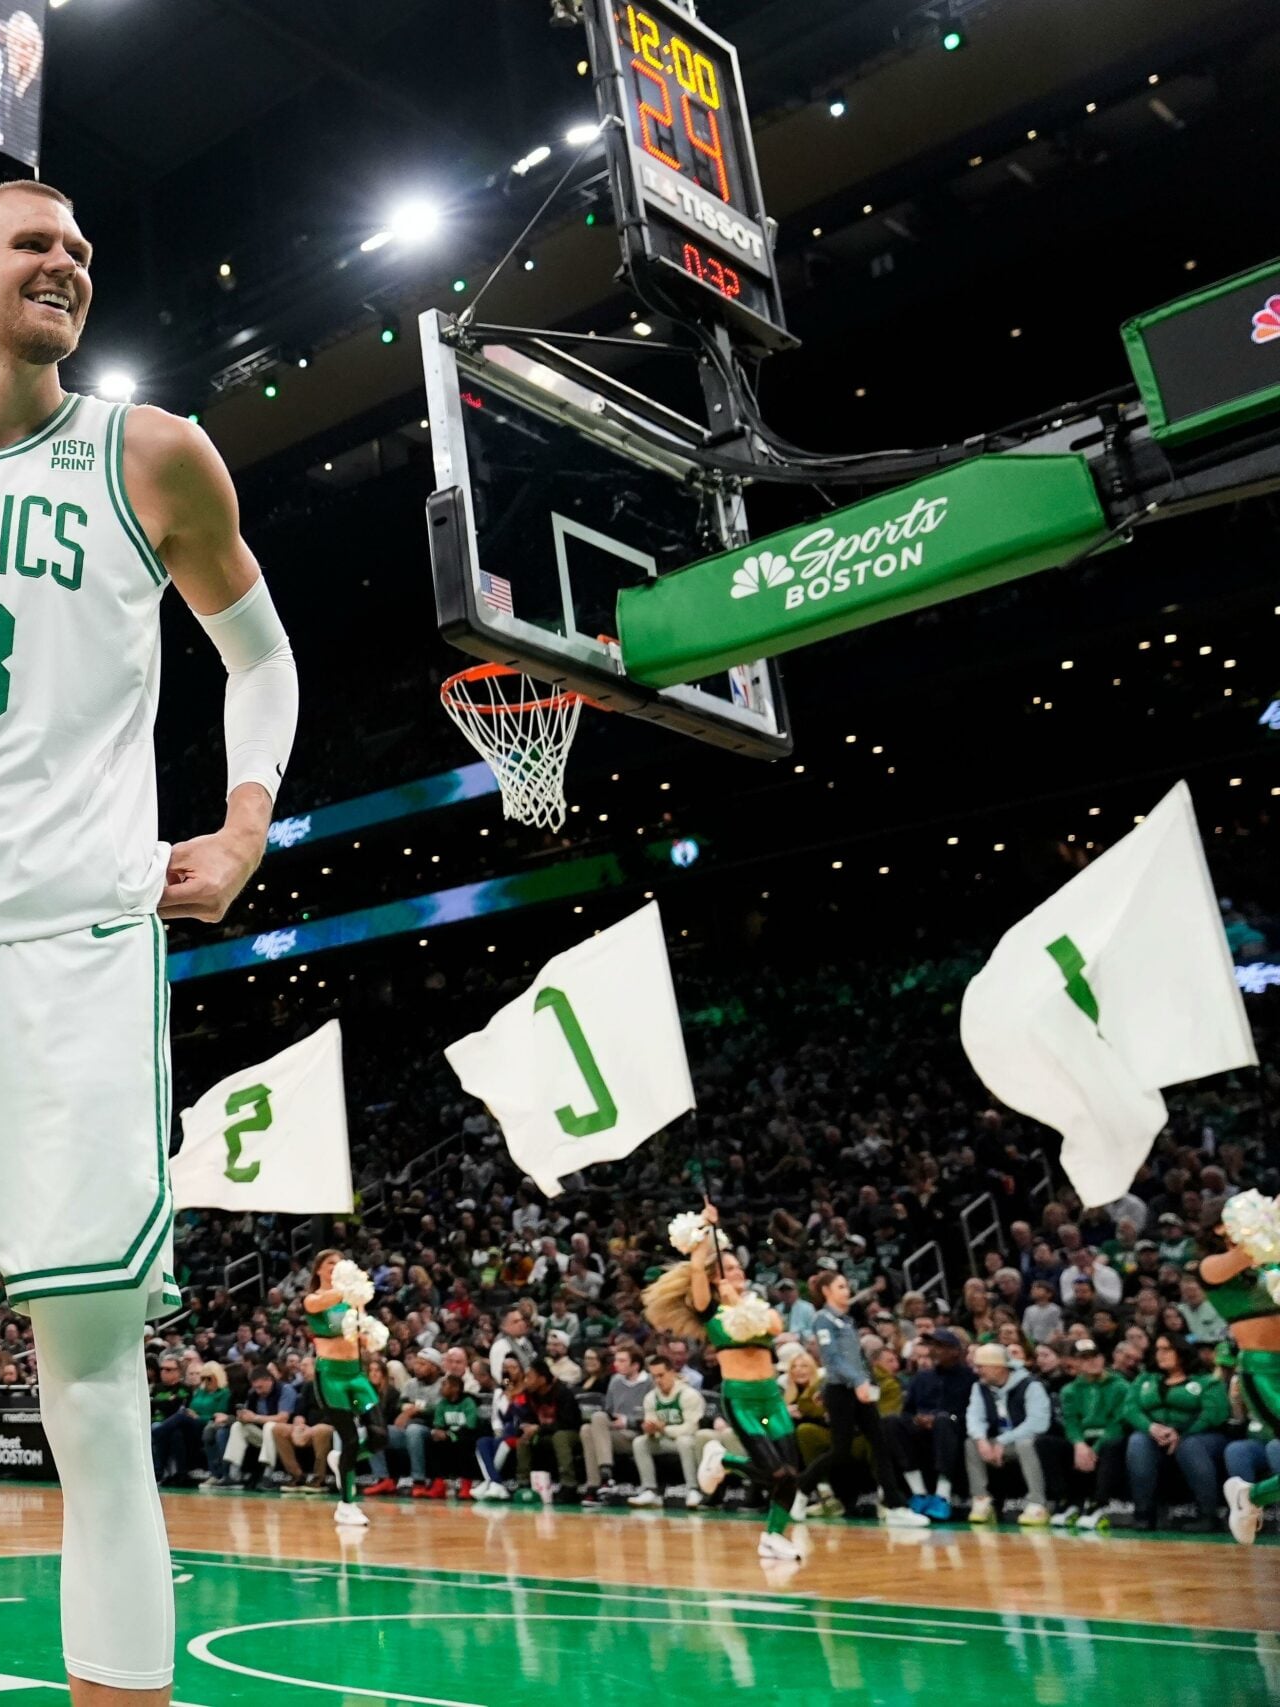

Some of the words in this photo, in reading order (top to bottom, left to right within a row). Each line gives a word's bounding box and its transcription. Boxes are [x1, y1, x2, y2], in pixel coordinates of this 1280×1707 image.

[627, 4, 720, 110] 12:00
[630, 58, 730, 204] 24
[676, 185, 764, 259] TISSOT
[50, 457, 96, 471] PRINT
[51, 439, 96, 459] VISTA
[789, 496, 949, 580] Sports
[784, 541, 924, 611] BOSTON
